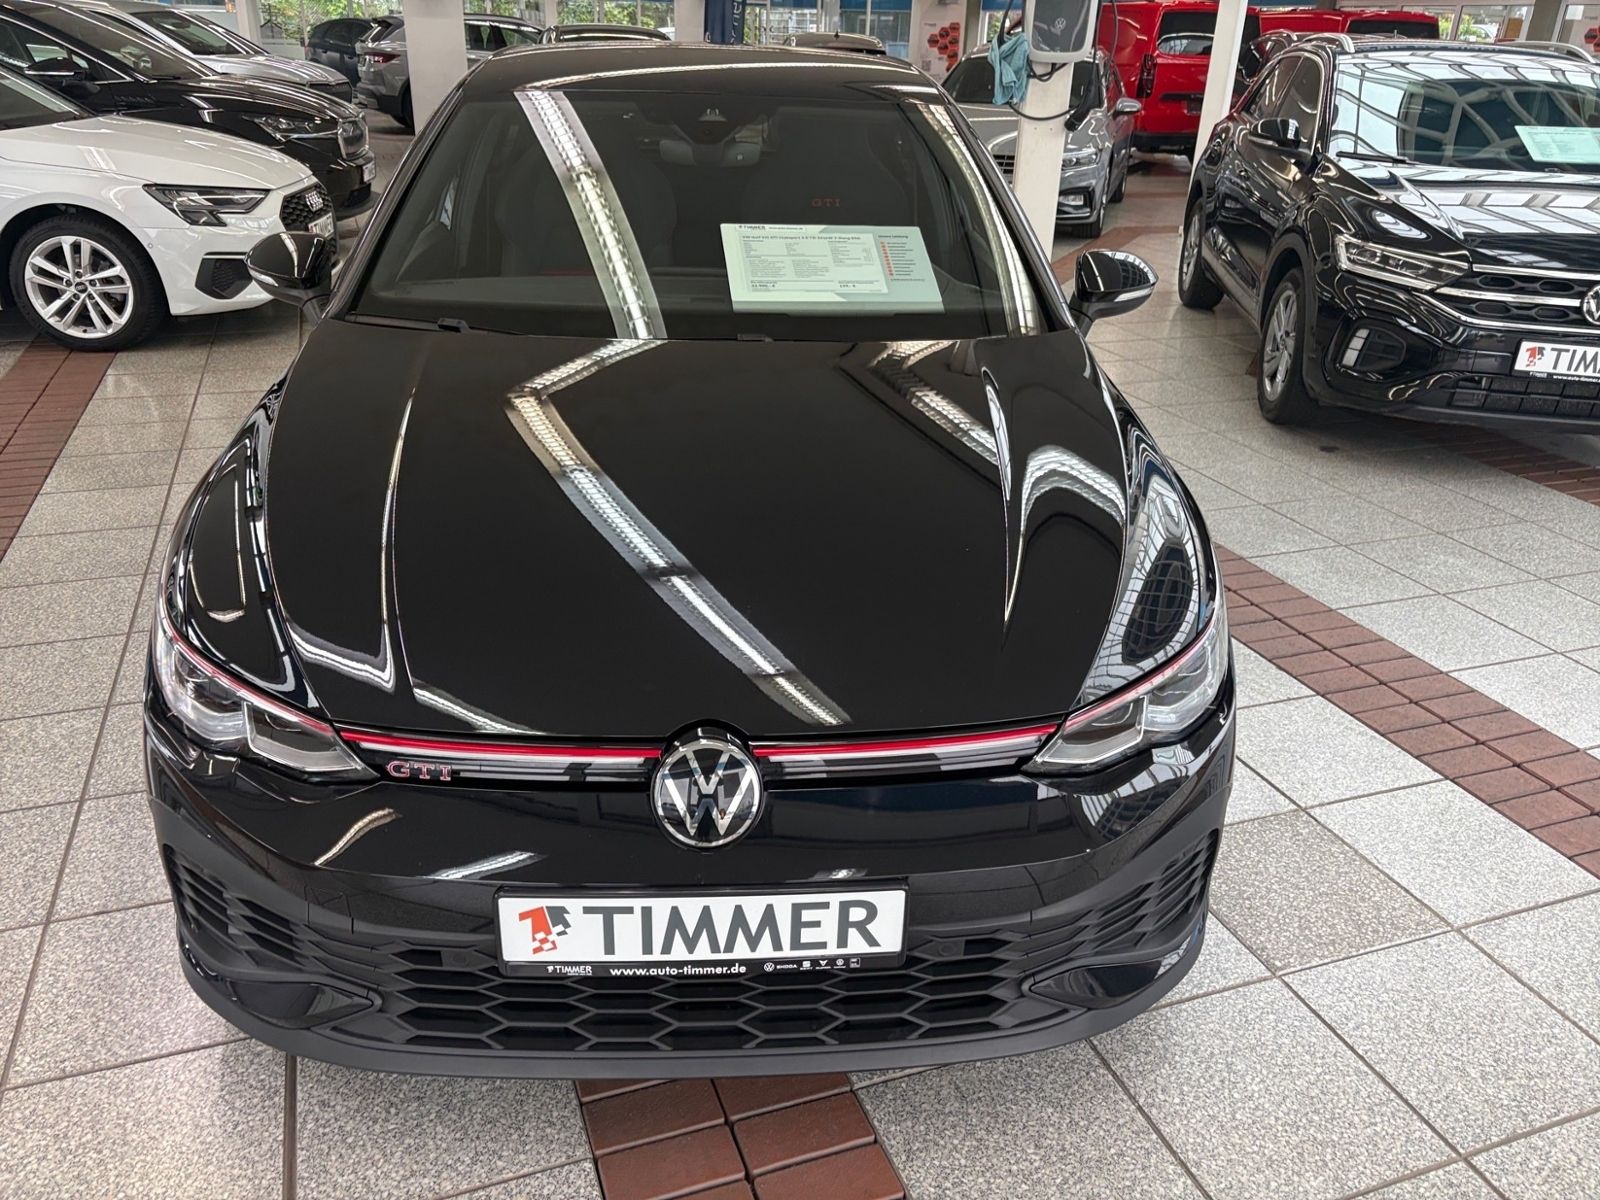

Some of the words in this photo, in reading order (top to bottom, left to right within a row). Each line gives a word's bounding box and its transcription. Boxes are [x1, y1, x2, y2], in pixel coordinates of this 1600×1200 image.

[811, 198, 840, 208] GTI
[1550, 347, 1600, 374] TIM
[386, 761, 451, 781] GTI
[582, 899, 882, 955] TIMMER
[555, 965, 592, 974] TIMMER
[609, 963, 747, 976] www.auto-timmer.de
